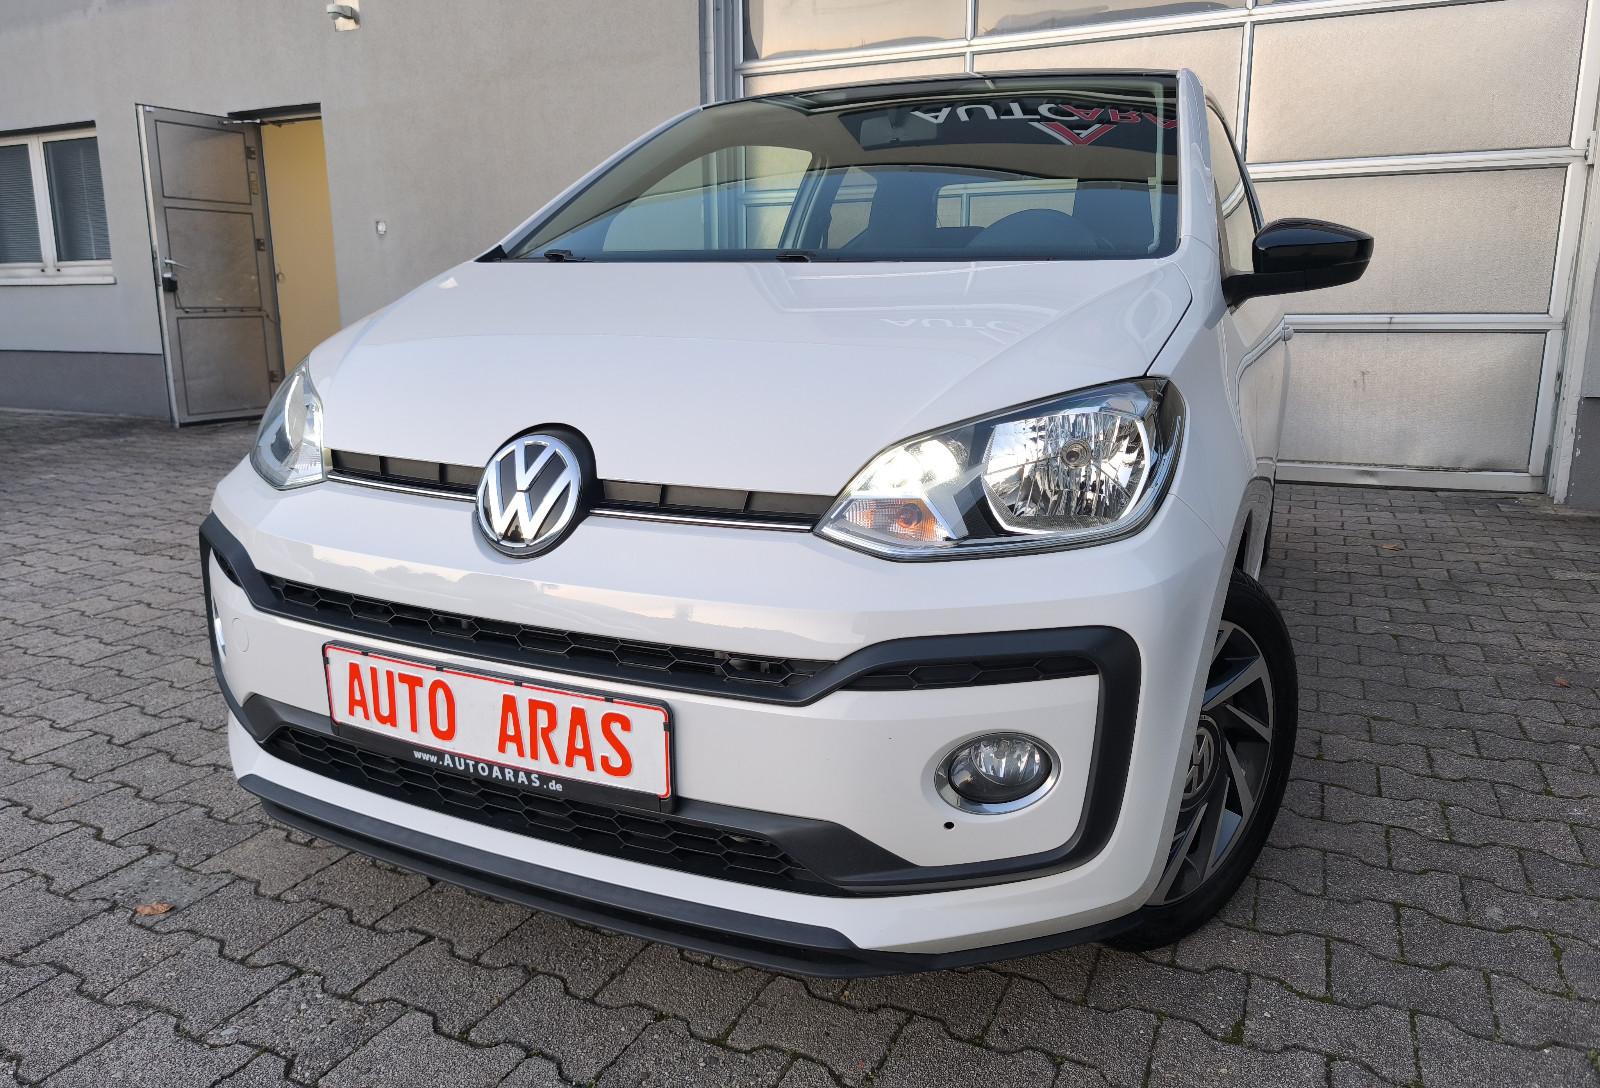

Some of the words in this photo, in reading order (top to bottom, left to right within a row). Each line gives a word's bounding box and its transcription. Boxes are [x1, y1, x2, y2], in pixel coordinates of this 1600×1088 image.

[348, 661, 456, 741] AUTO
[497, 693, 633, 777] ARAS
[413, 750, 563, 792] www.AUTOARAS.de
